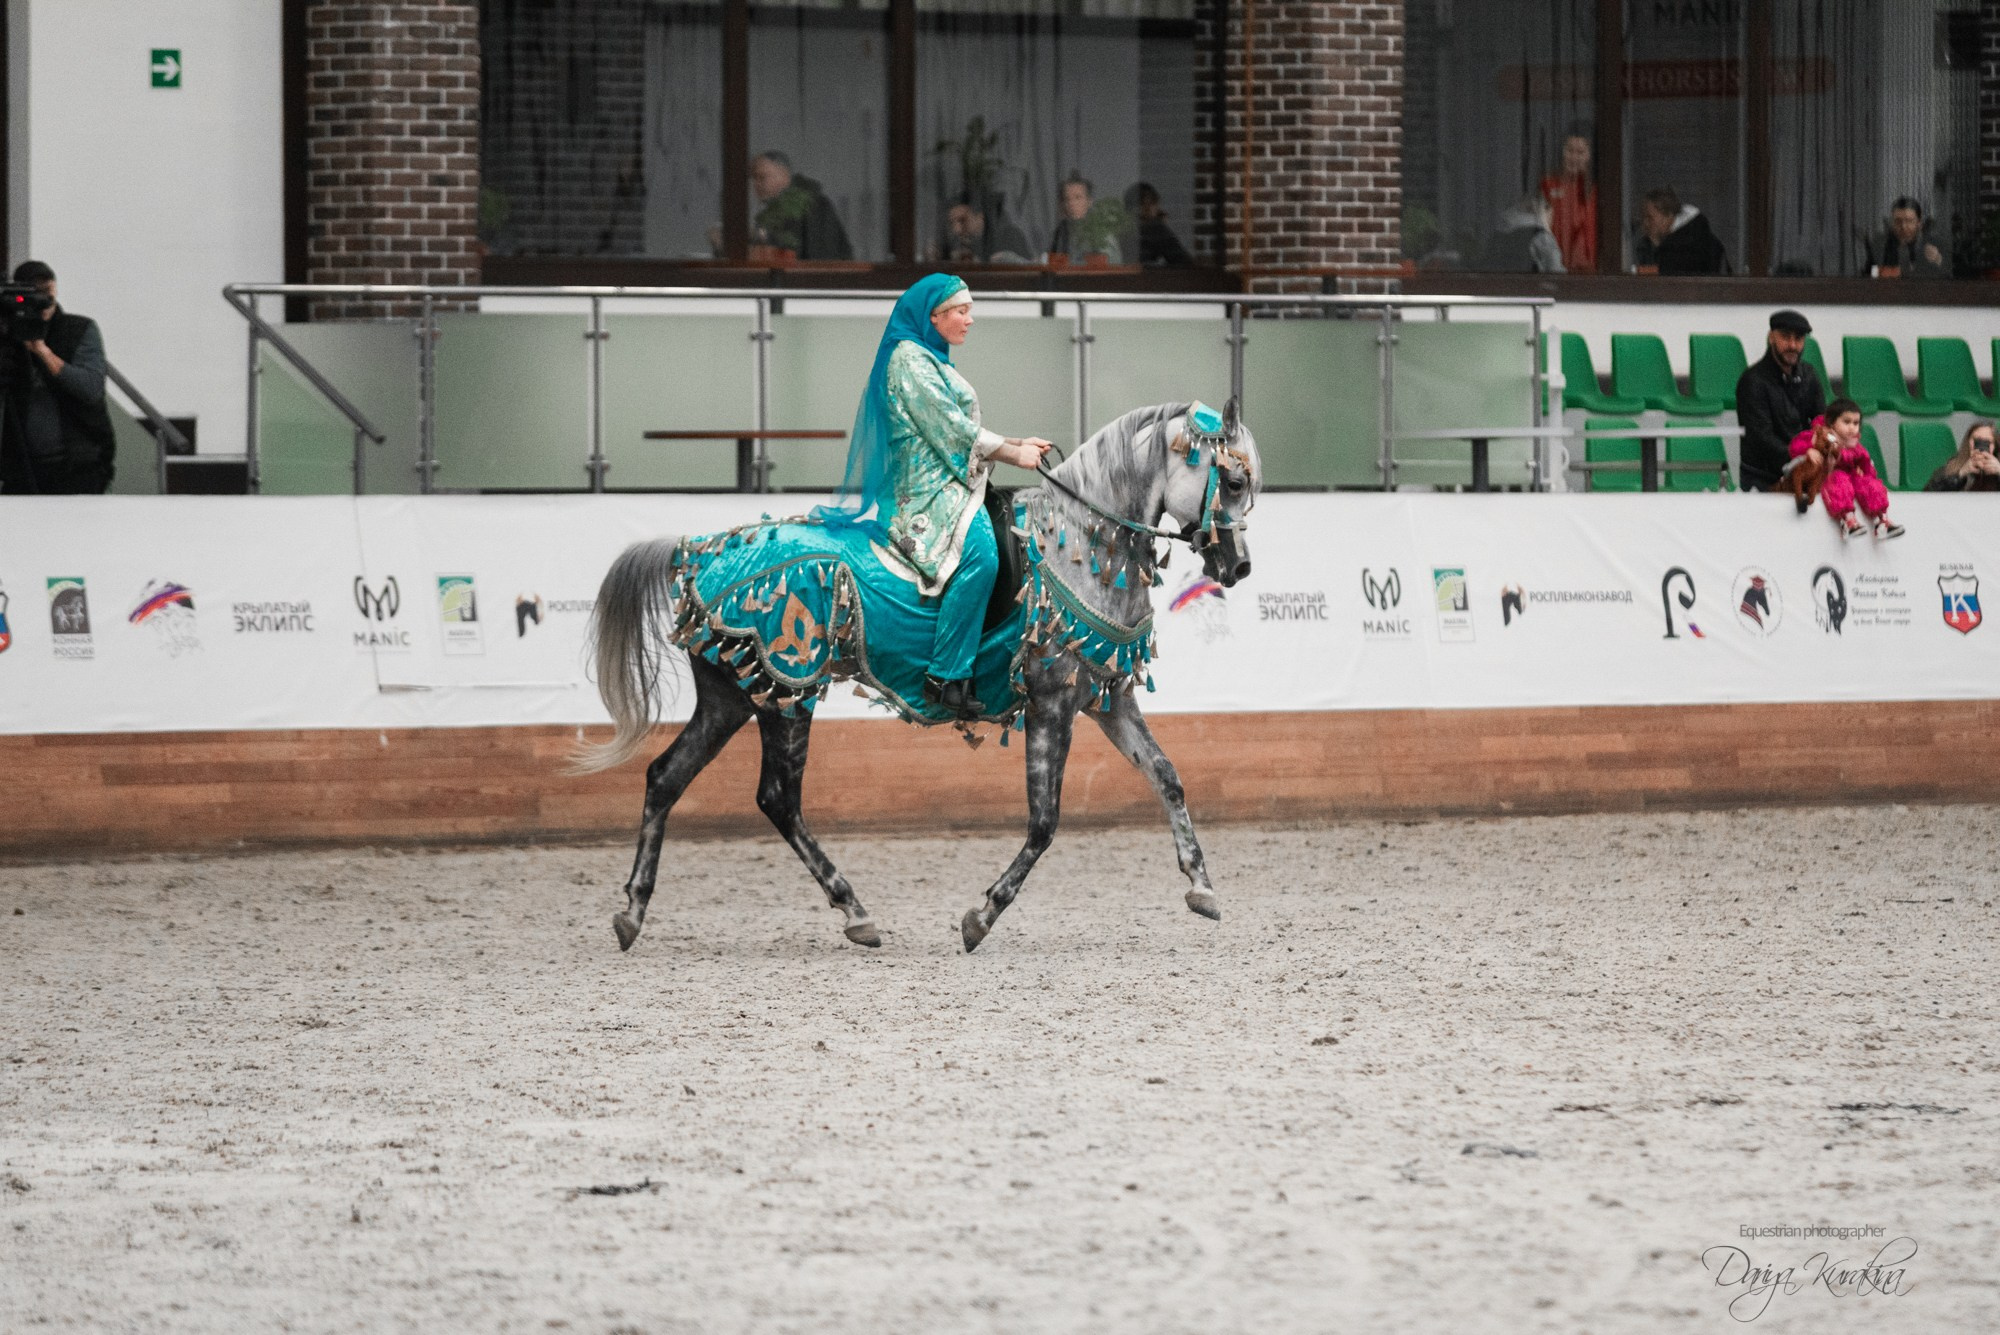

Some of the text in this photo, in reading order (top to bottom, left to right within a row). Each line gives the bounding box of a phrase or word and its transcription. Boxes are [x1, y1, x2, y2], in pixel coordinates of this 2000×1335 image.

[1654, 0, 1739, 25] MANI
[1258, 590, 1326, 604] КРЫЛАТЫЙ
[1529, 590, 1633, 604] РОСПЛЕМКОНЗАВОД
[232, 600, 312, 614] КРЫЛАТЫЙ
[1260, 604, 1329, 621] ЭКЛИПС
[235, 615, 315, 633] ЭКЛИПС
